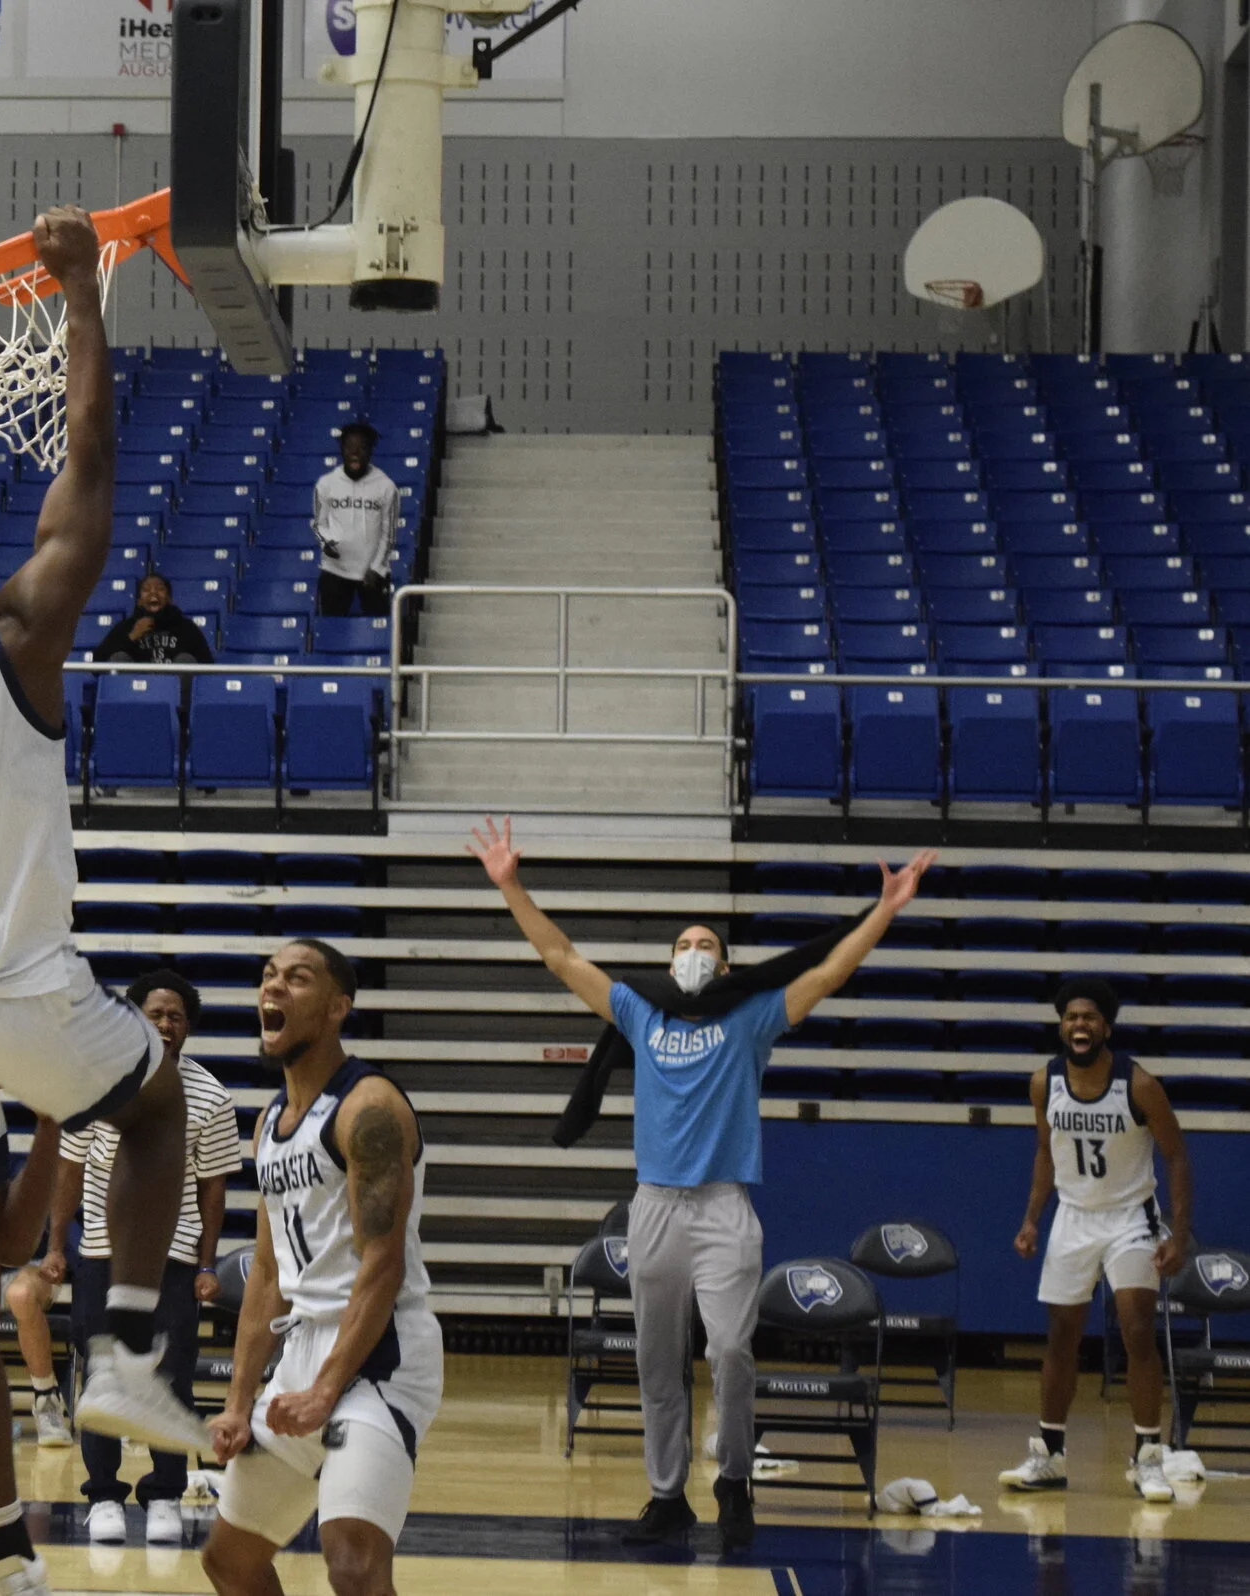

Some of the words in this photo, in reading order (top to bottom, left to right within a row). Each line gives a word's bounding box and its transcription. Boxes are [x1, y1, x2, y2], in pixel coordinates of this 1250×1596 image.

[118, 62, 172, 78] AUGU
[1053, 1111, 1126, 1133] AUGUSTA
[1073, 1138, 1107, 1178] 13
[283, 1204, 314, 1277] 11
[604, 1337, 637, 1349] JAGU
[768, 1380, 829, 1394] JAGUARS
